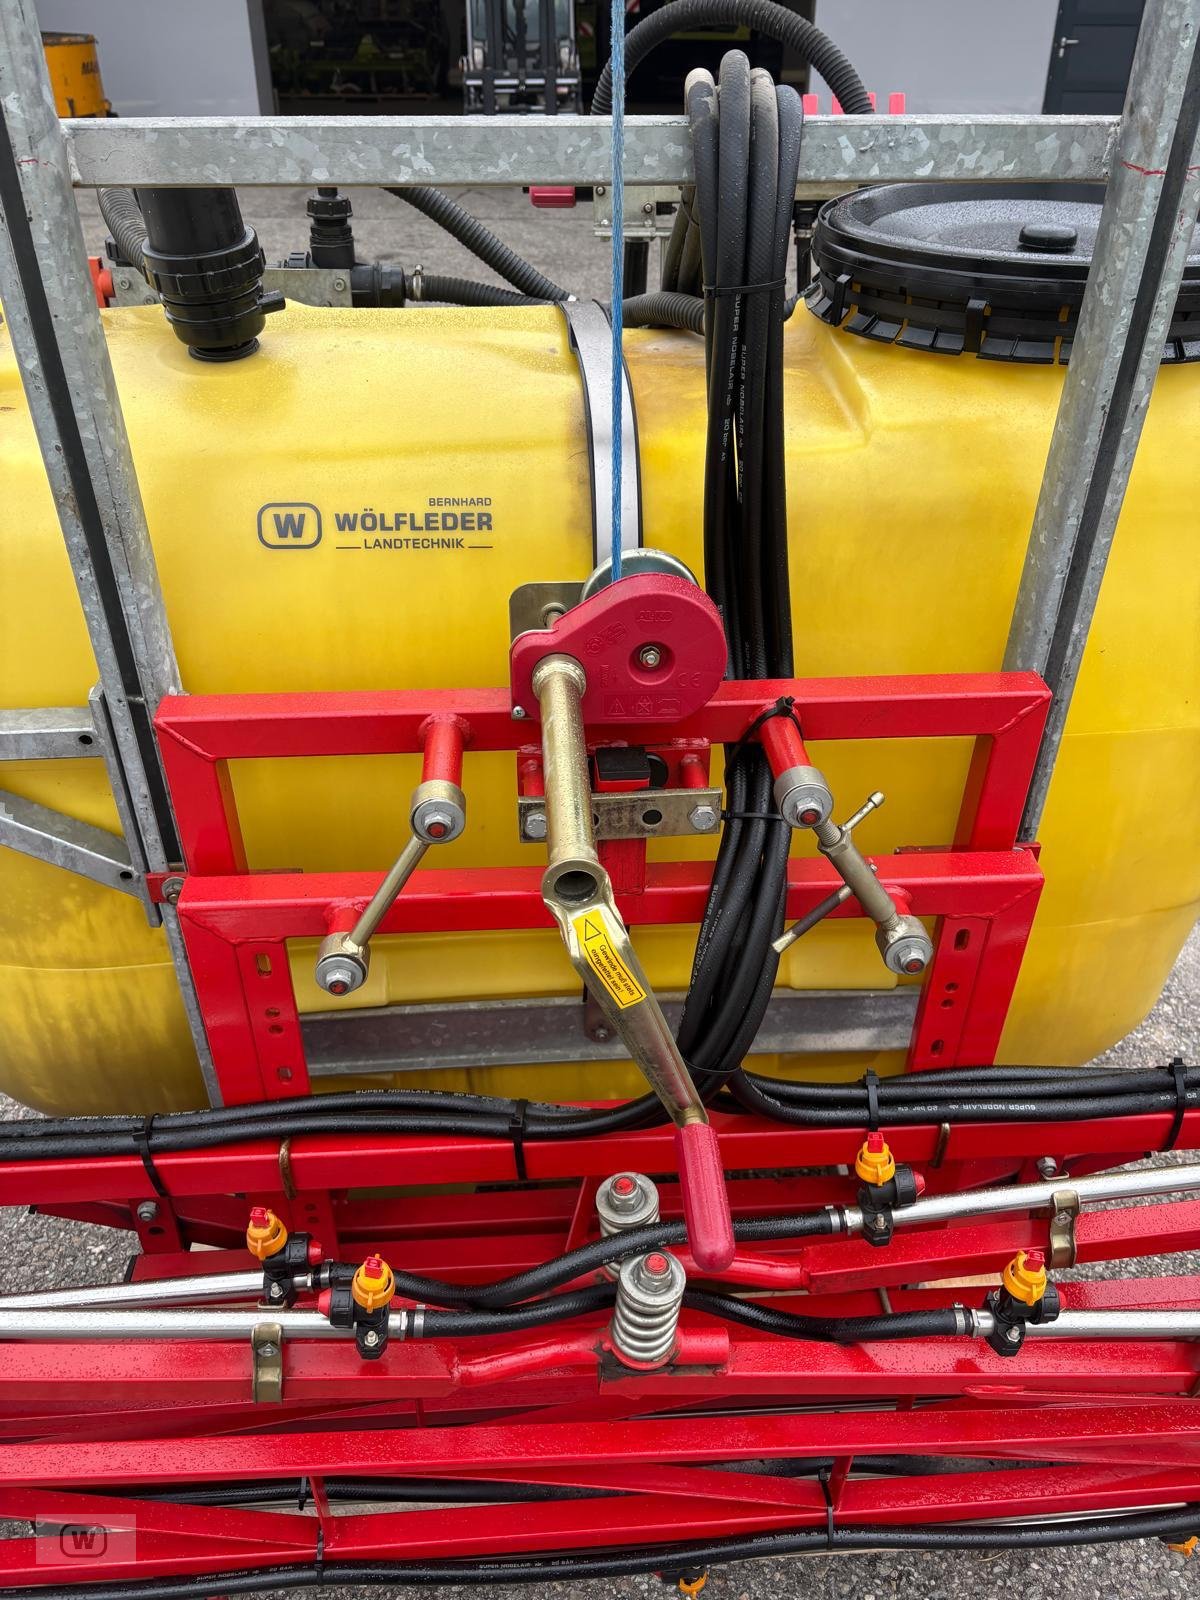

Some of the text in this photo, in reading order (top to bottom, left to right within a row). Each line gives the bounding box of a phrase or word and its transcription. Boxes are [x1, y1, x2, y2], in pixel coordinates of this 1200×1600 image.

[429, 497, 492, 507] BERNHARD
[273, 513, 306, 538] W
[335, 508, 493, 531] WÖLFLEDER
[364, 538, 465, 549] LANDTECHNIK
[599, 944, 618, 972] Gewinde
[623, 981, 636, 996] stets
